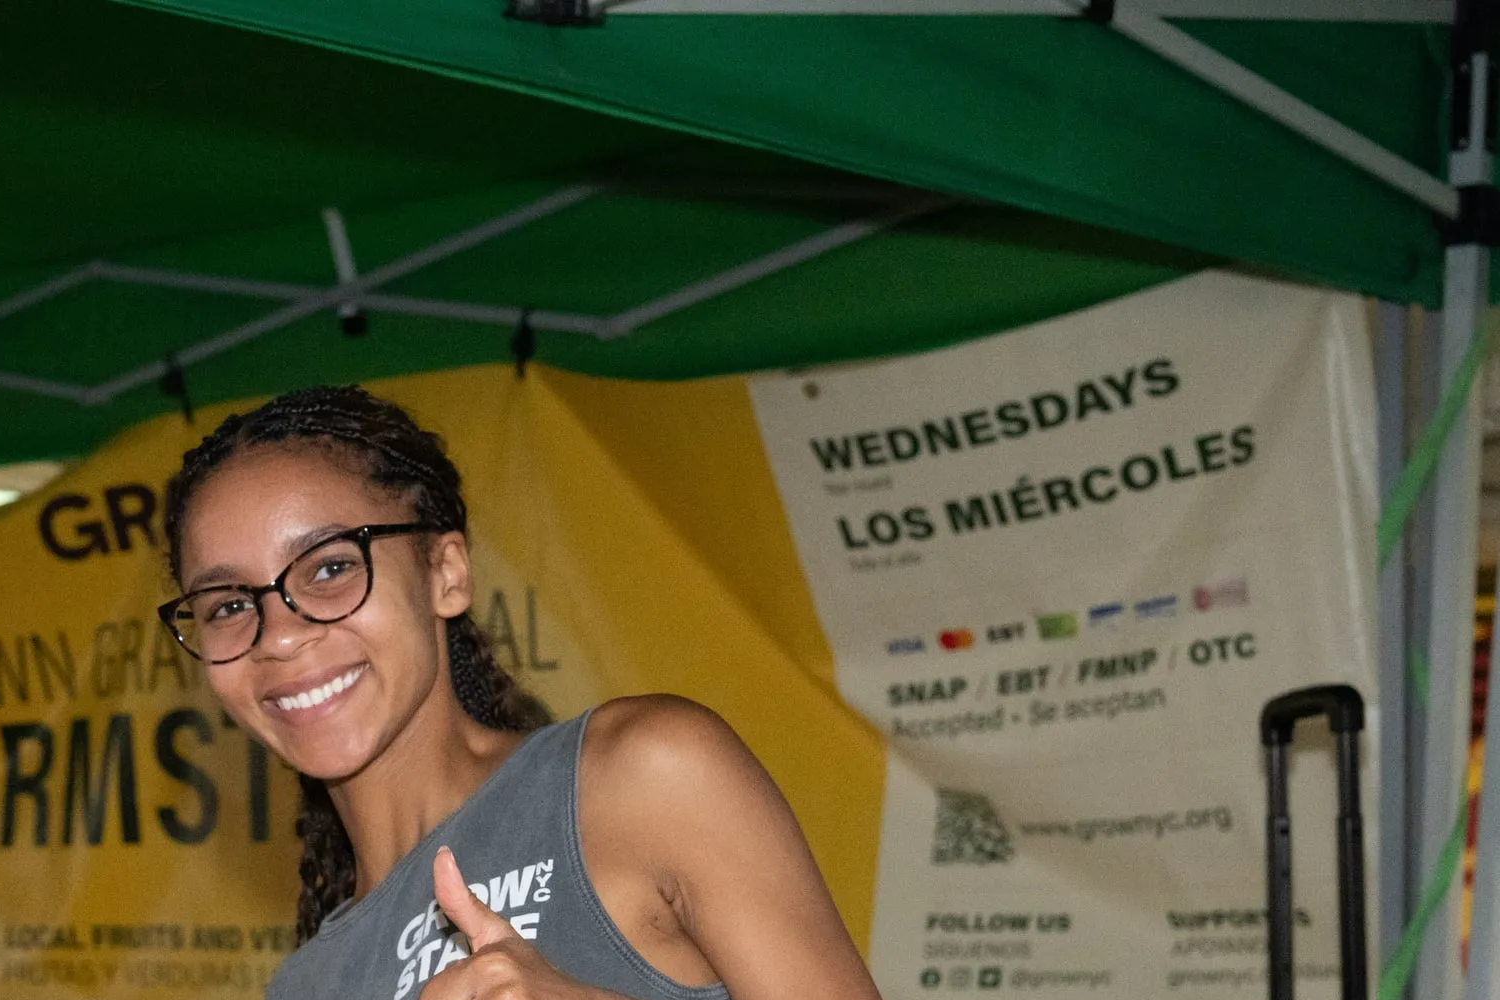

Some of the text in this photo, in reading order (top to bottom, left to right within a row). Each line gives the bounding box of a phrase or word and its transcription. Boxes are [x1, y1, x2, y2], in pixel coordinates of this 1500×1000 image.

[810, 357, 1181, 474] WEDNESDAYS
[39, 484, 156, 560] GR
[836, 425, 1257, 550] LOS MIÉRCOLES
[90, 617, 192, 698] GRA
[485, 586, 562, 670] AL
[887, 677, 968, 707] SNAP
[997, 665, 1051, 696] EBT
[1077, 649, 1157, 684] FMNP
[1187, 632, 1257, 666] OTC
[925, 912, 1072, 933] FOLLOW US
[1166, 908, 1268, 932] SUPPOR
